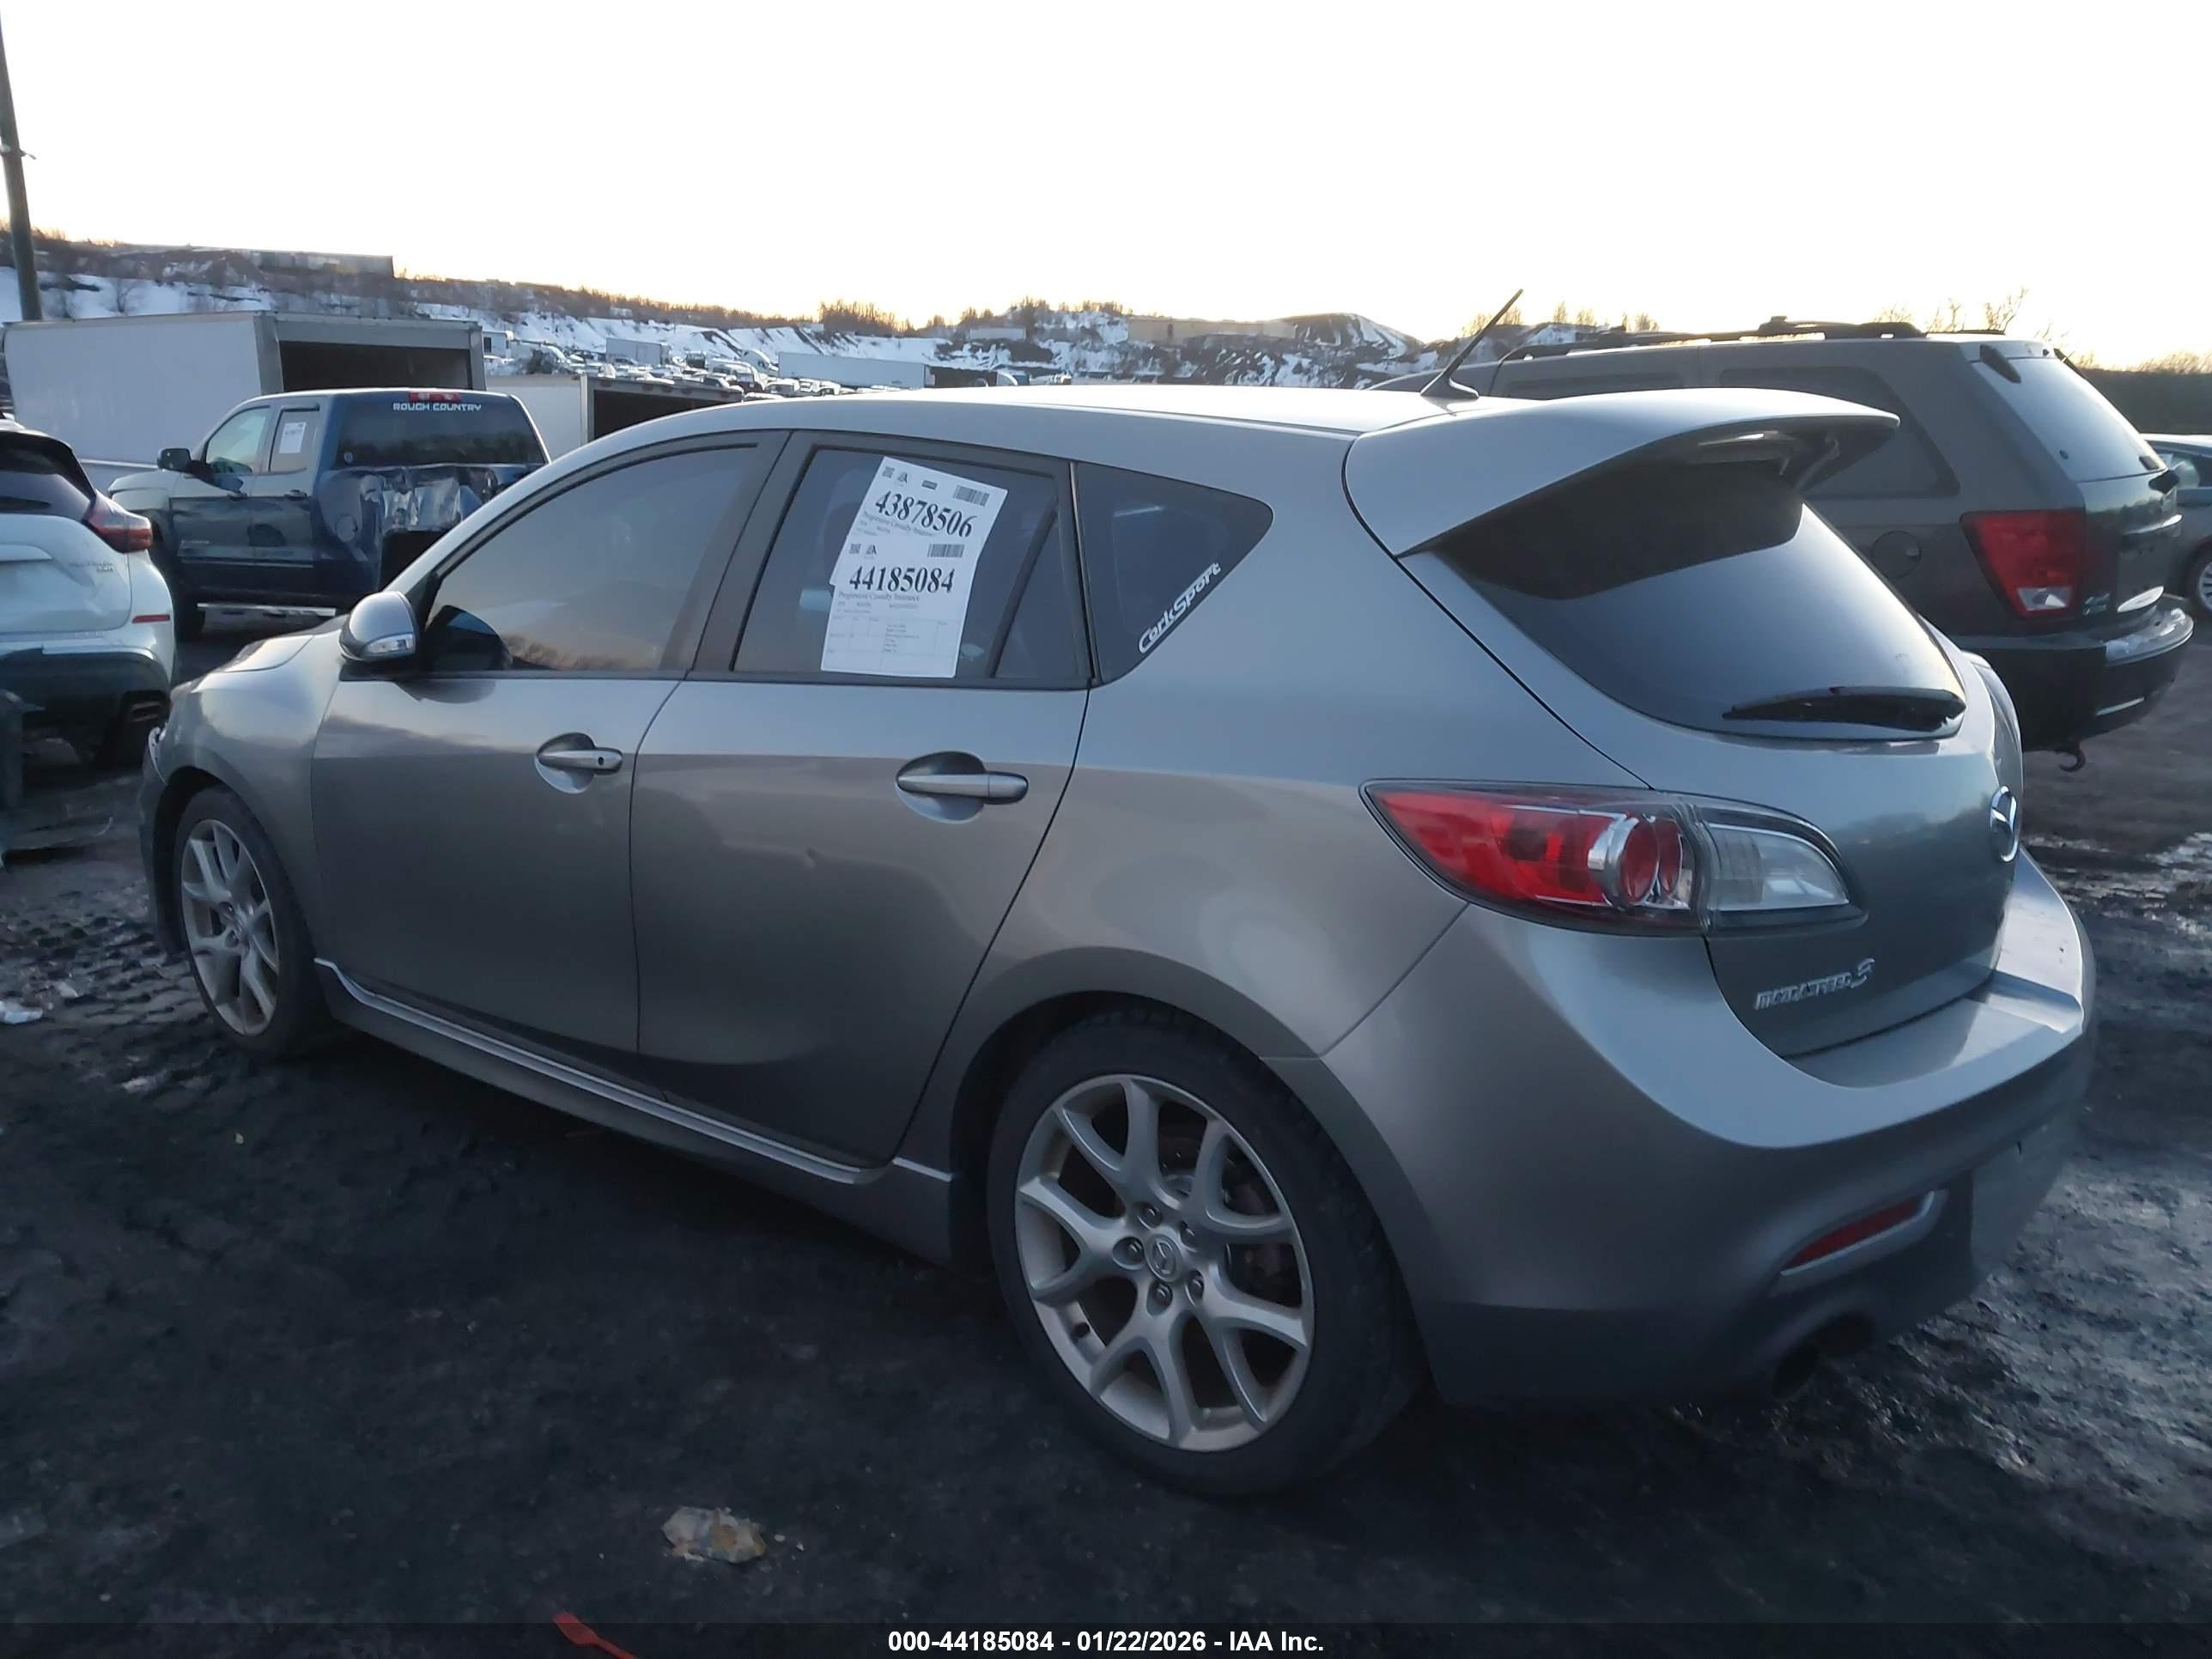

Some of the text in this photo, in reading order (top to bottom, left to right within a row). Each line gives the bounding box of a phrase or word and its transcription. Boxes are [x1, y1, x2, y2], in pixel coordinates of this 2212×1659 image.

[433, 404, 482, 412] COUNTRY
[875, 490, 978, 538] 43878506
[849, 566, 956, 593] 44185084
